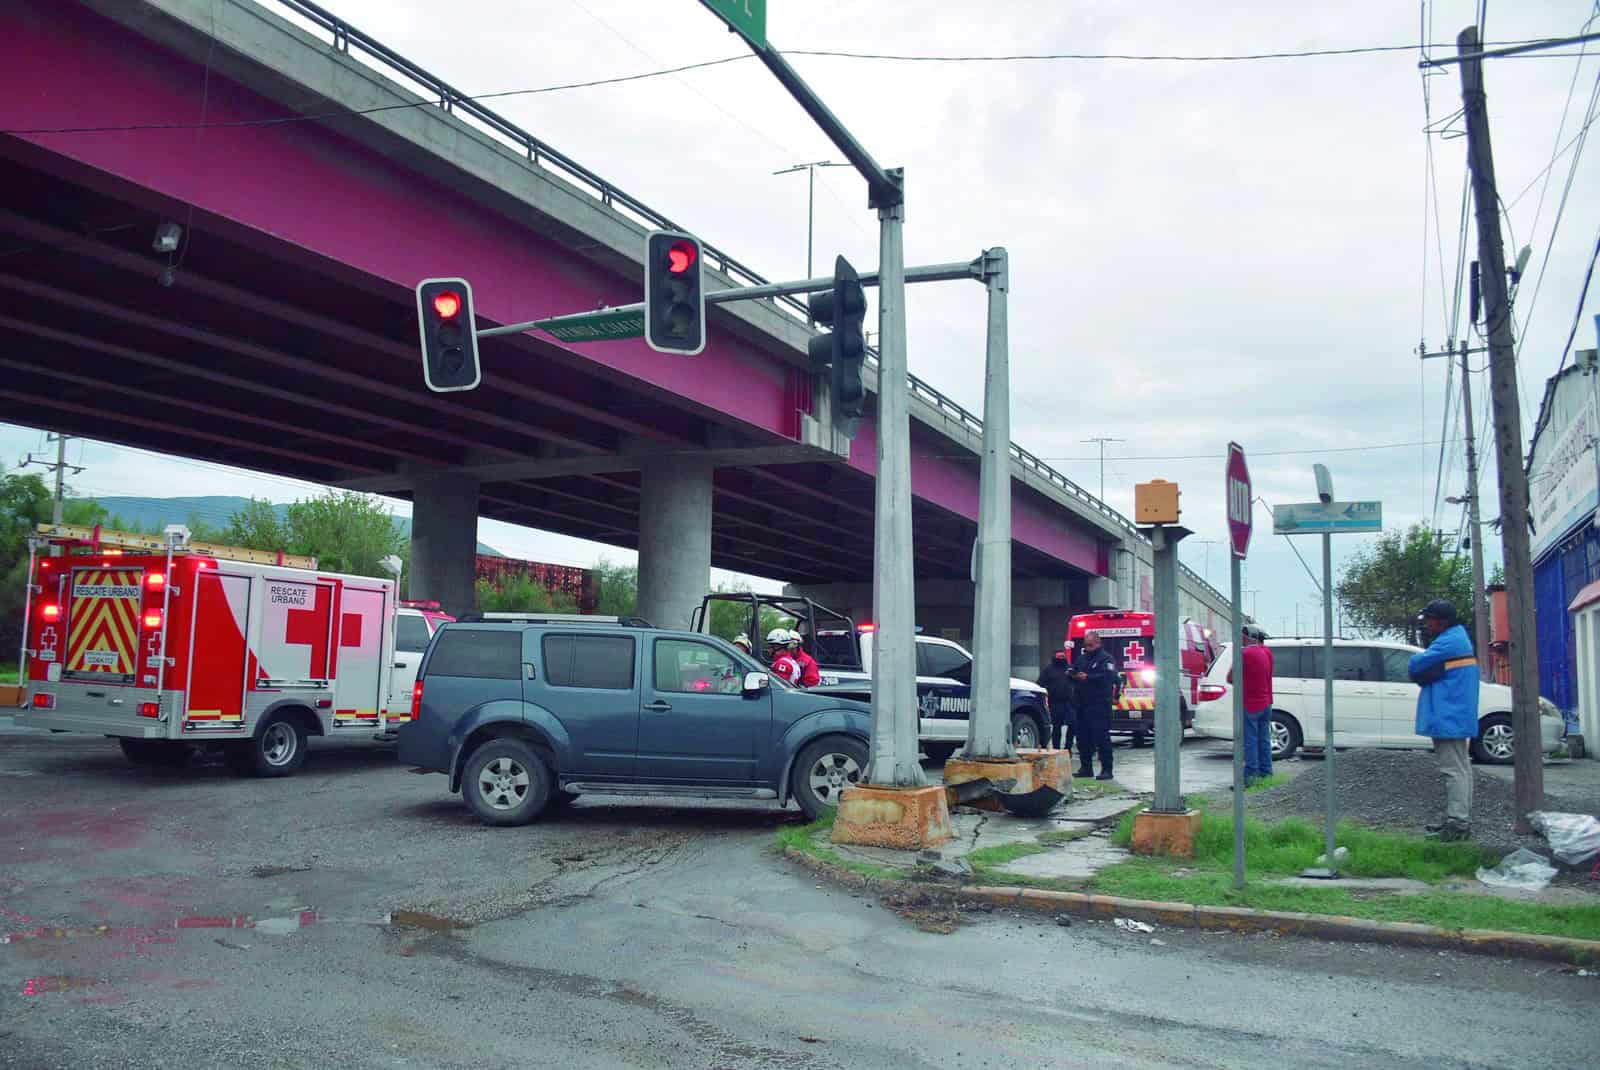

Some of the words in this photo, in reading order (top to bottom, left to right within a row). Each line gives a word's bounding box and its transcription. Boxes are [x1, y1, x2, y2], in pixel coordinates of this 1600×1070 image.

[76, 586, 107, 597] RESCATE
[108, 587, 139, 598] URBANO
[271, 586, 307, 597] RESCATE
[271, 596, 305, 605] URBANO
